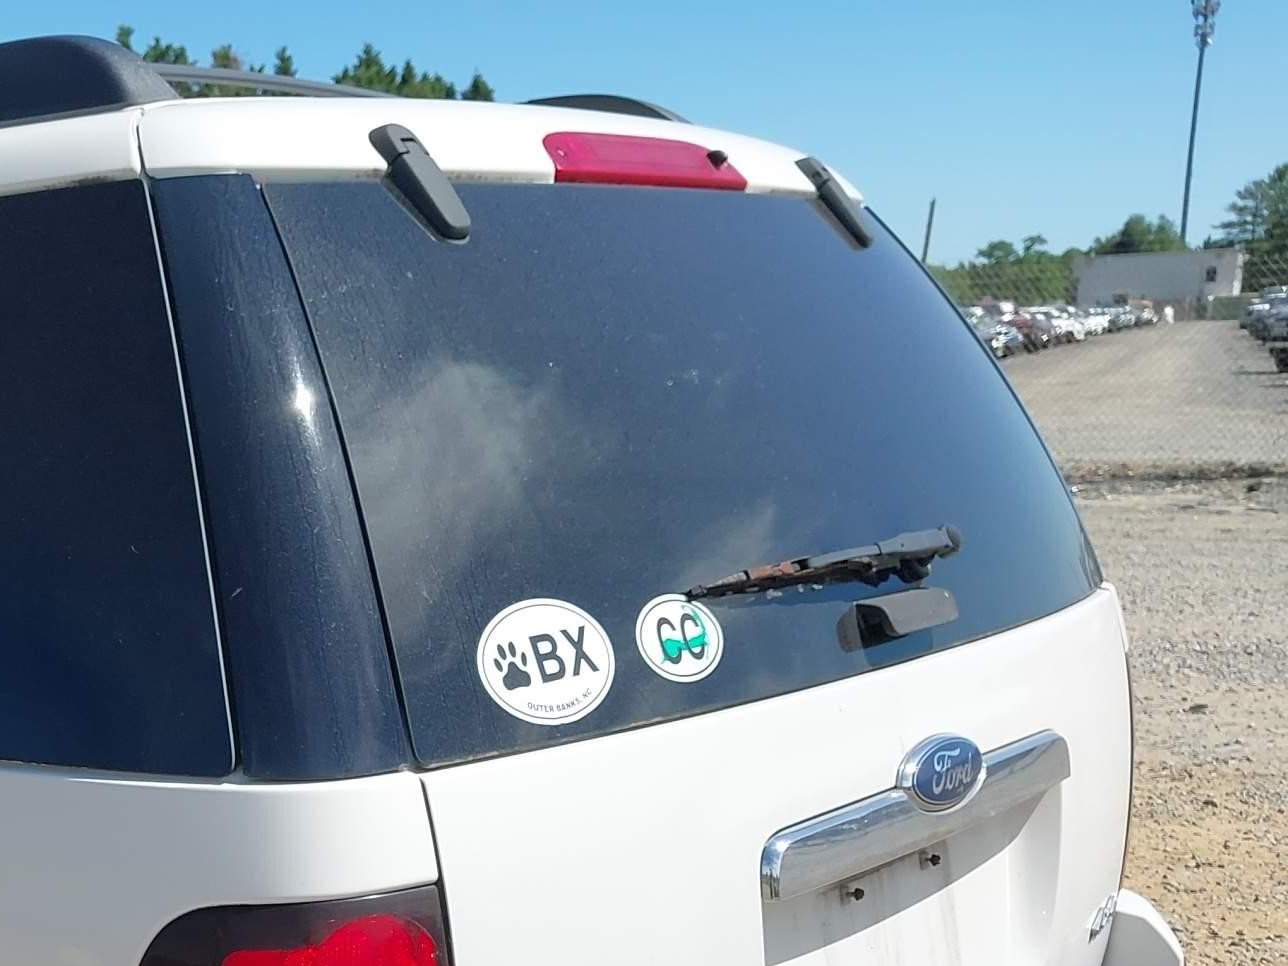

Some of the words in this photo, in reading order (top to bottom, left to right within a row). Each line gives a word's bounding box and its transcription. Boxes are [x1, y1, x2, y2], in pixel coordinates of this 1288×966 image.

[528, 702, 555, 713] OUTER
[582, 688, 593, 699] NC
[932, 747, 974, 795] Ford
